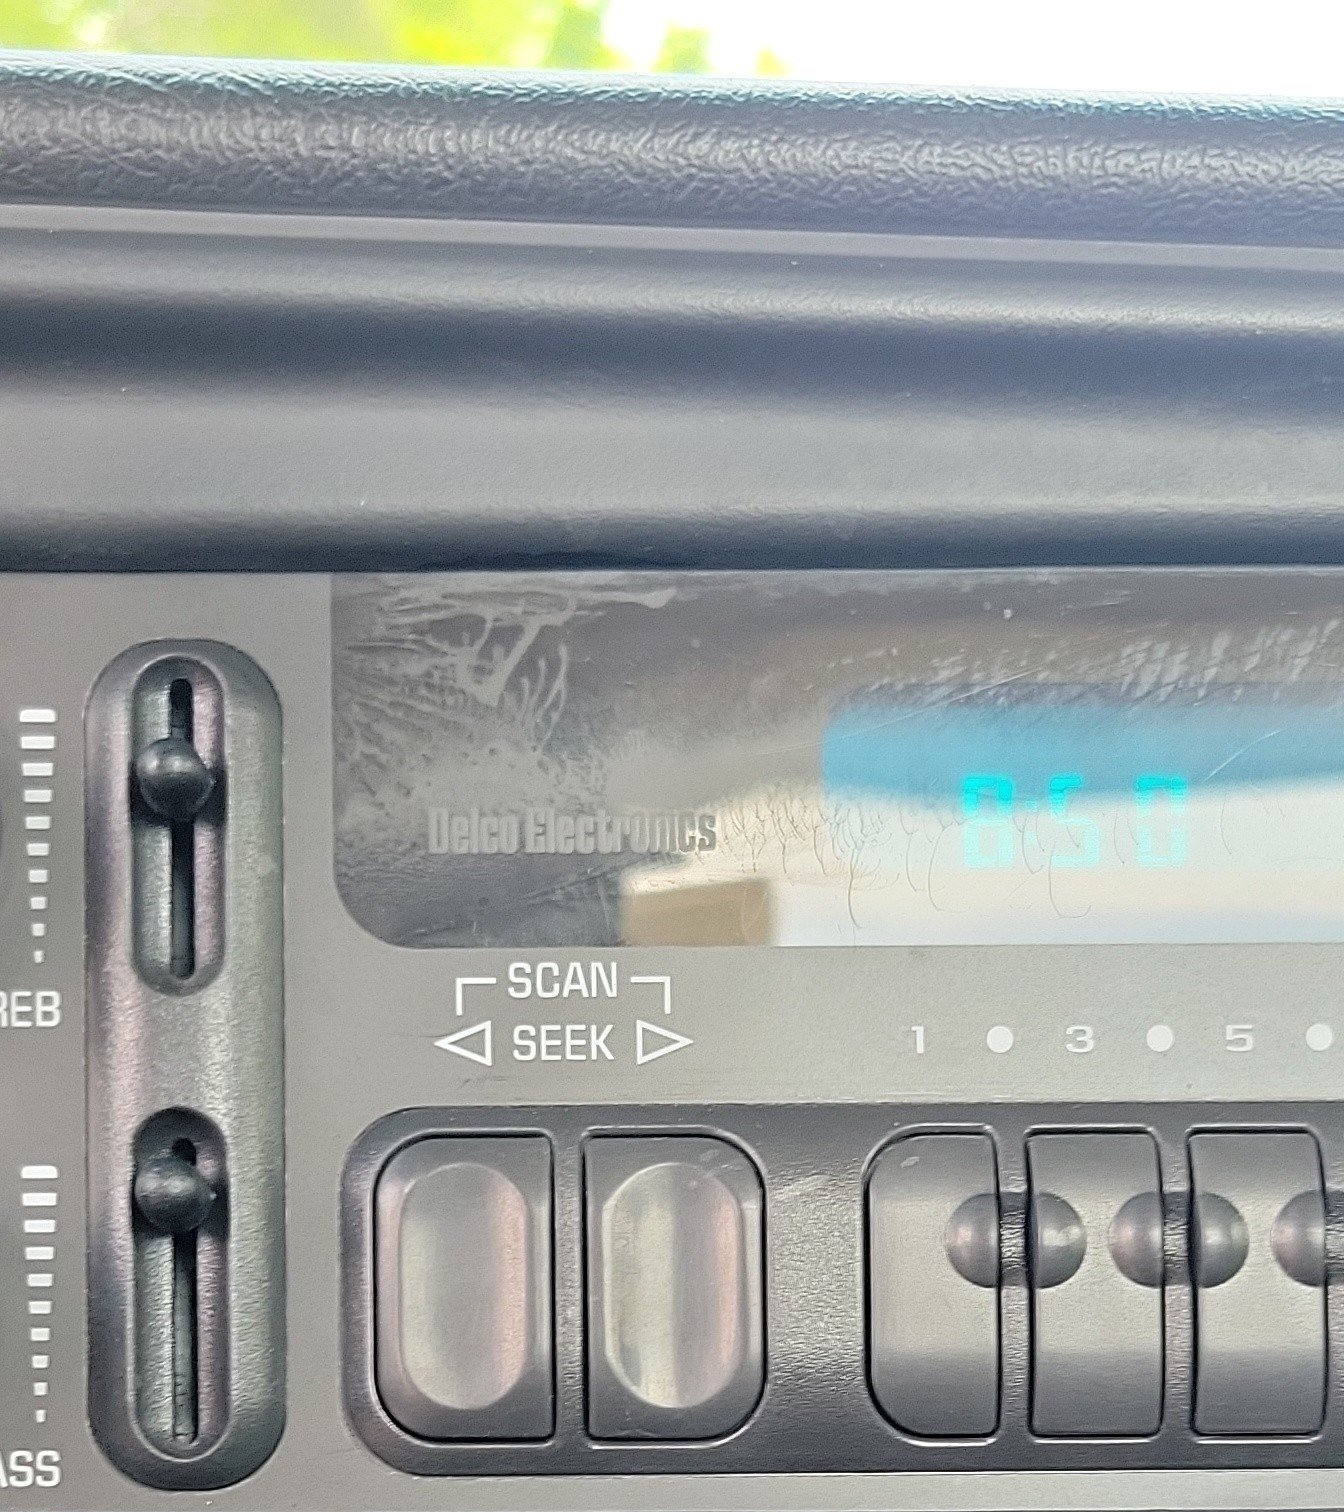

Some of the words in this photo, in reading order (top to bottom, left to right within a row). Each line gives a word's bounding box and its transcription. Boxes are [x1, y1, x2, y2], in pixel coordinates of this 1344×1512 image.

[428, 806, 518, 855] Delco
[524, 806, 717, 855] Electronics
[507, 961, 618, 999] SCAN
[512, 1024, 615, 1061] SEEK
[910, 1025, 926, 1054] 1
[1065, 1025, 1095, 1053] 3
[1225, 1024, 1255, 1052] 5
